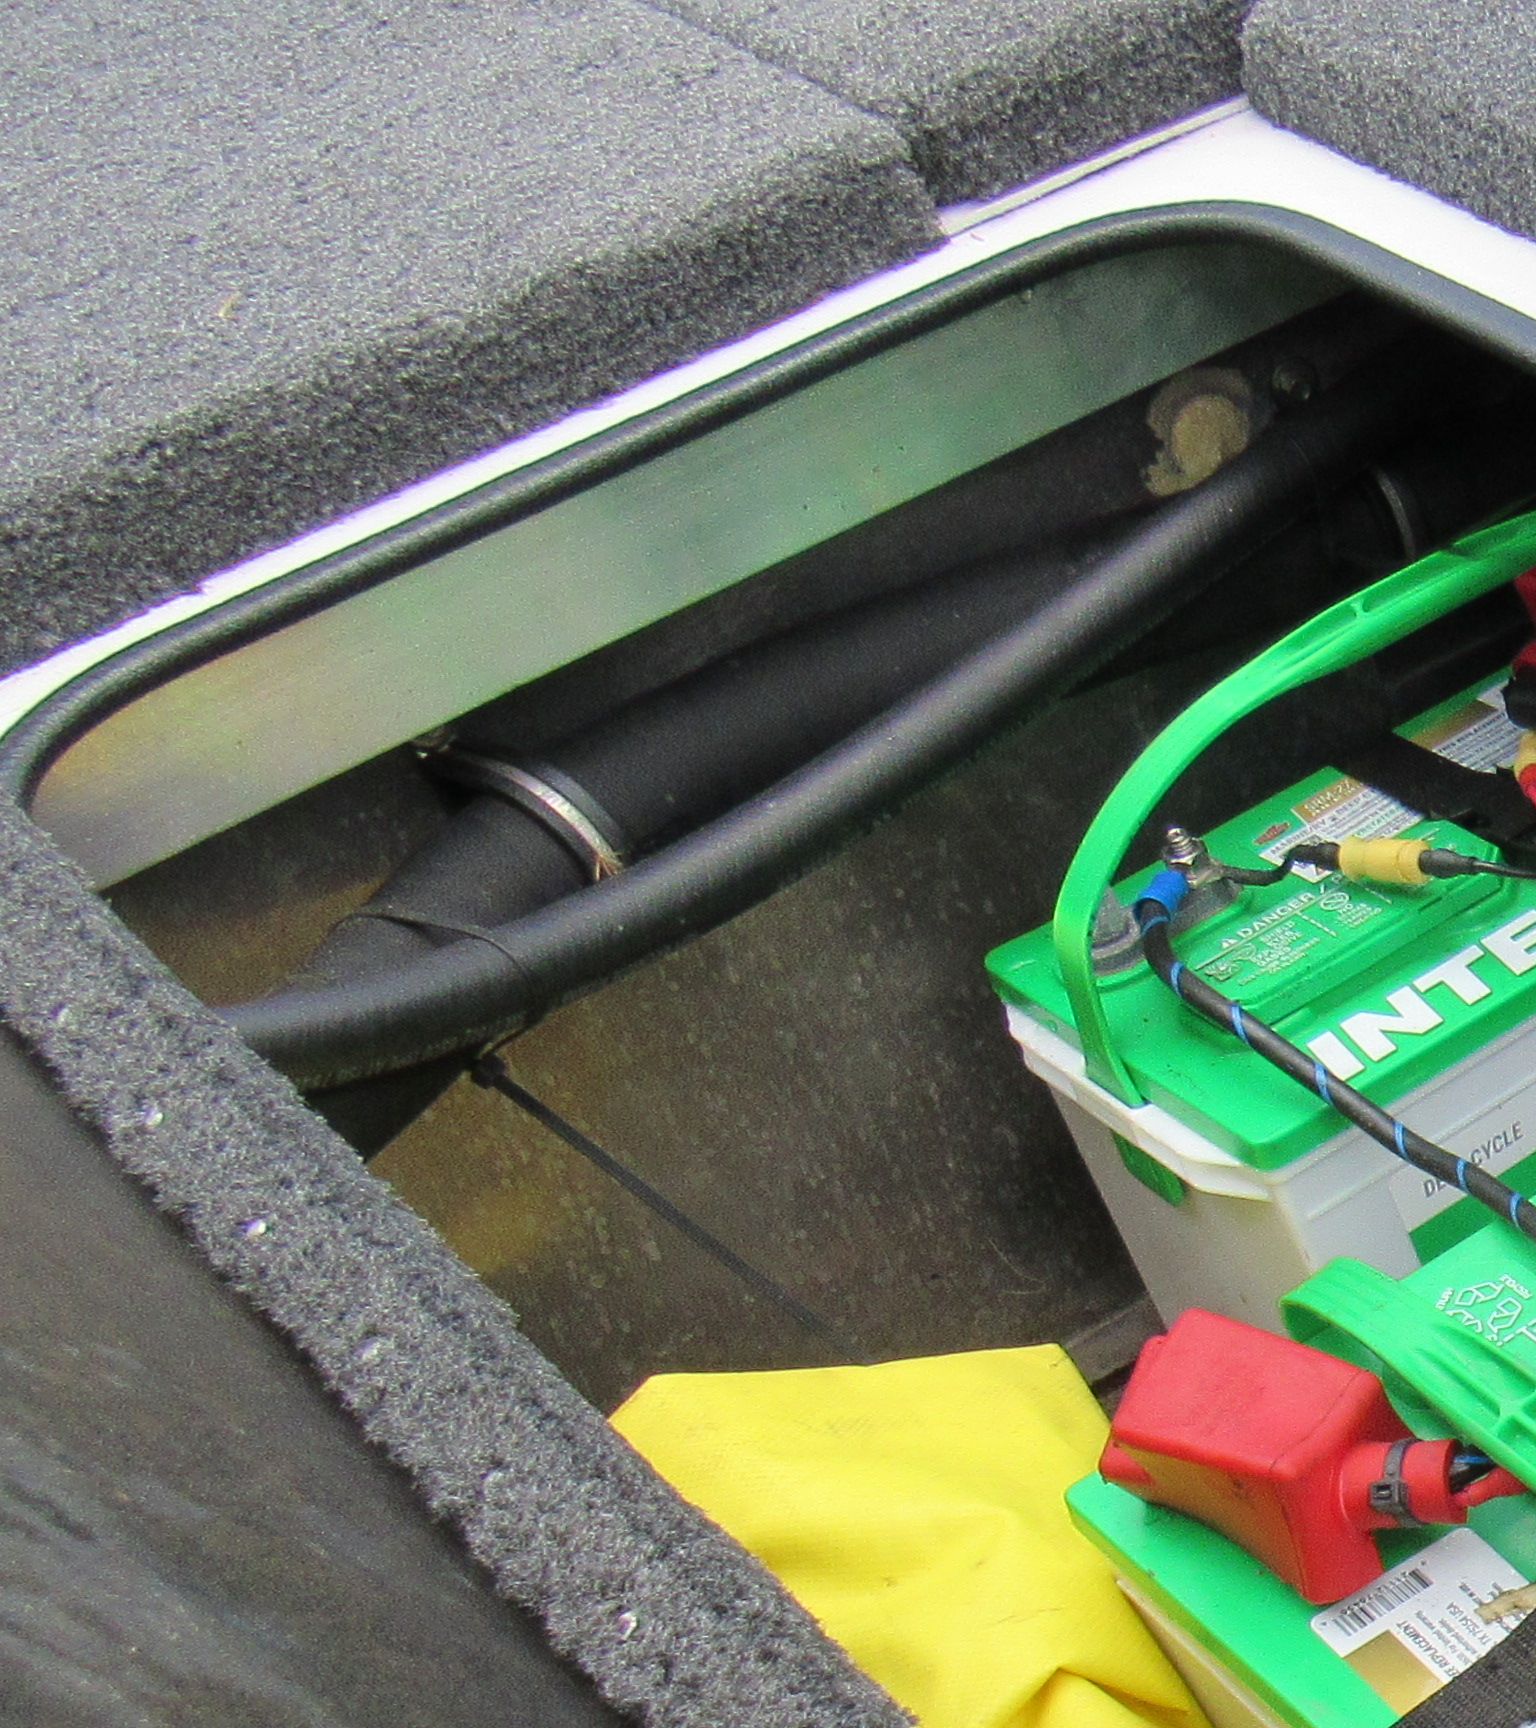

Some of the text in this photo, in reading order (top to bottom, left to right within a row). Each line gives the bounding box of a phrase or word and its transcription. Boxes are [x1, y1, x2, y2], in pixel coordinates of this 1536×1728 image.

[1236, 890, 1316, 941] DANGER
[1467, 1120, 1527, 1167] CYCLE
[1444, 1601, 1464, 1618] USA
[1395, 1618, 1450, 1669] REPLACEMENT
[1476, 1632, 1492, 1645] TX
